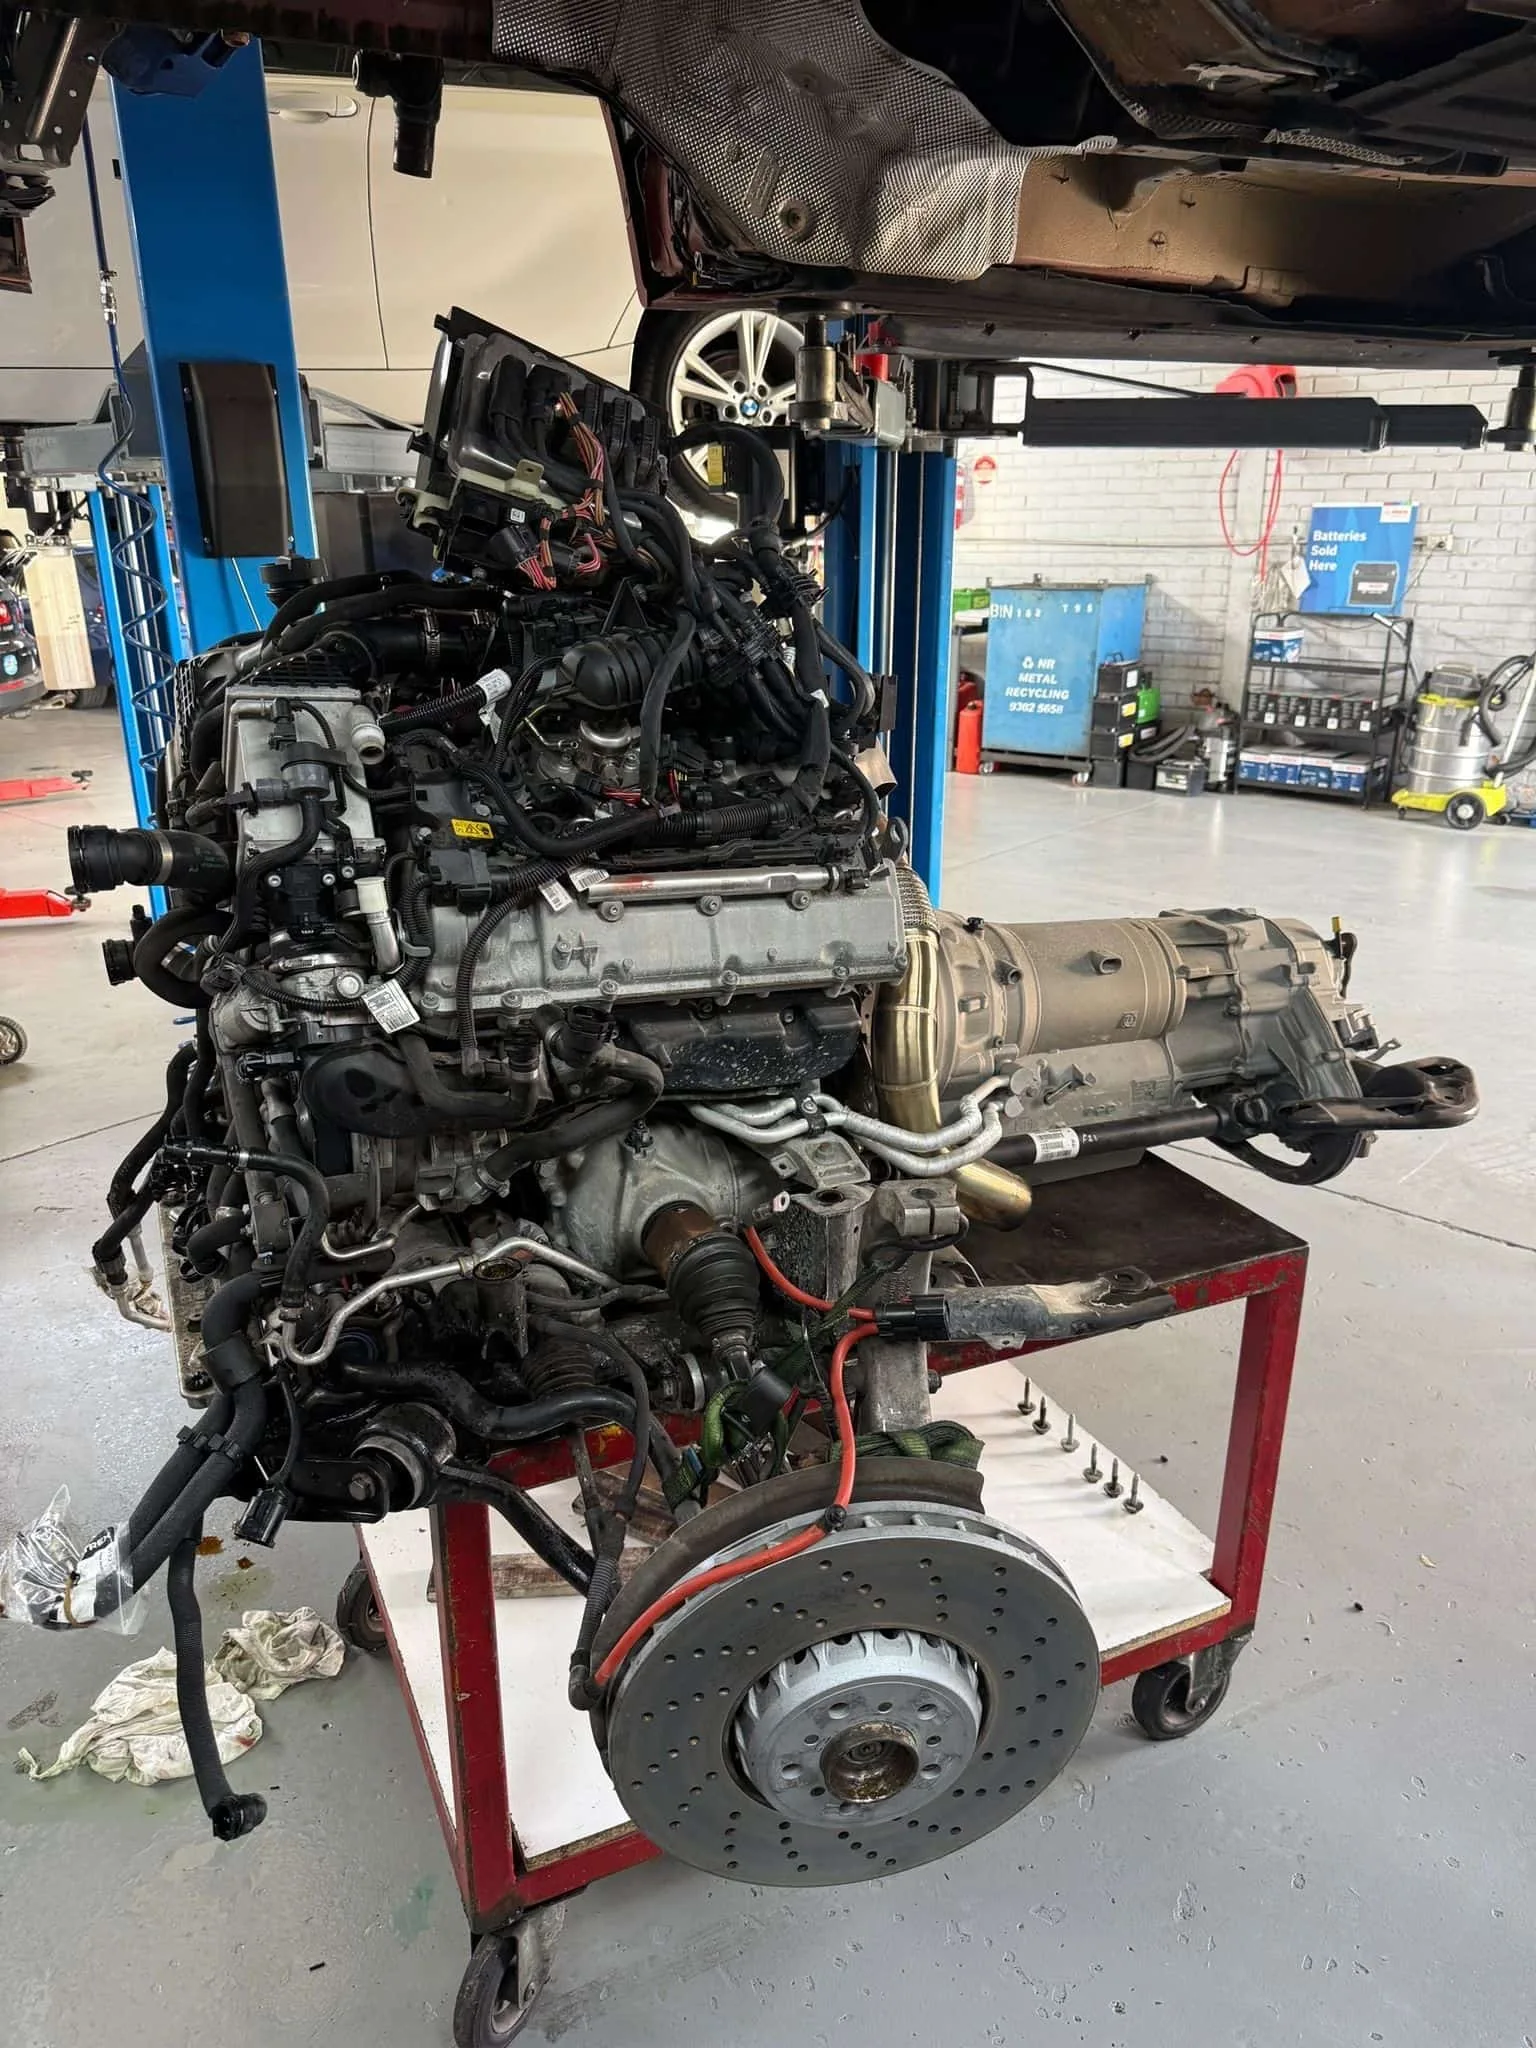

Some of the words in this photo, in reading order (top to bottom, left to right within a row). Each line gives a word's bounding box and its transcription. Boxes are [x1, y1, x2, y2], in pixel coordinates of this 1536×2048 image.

[1313, 530, 1367, 542] Batteries
[1310, 544, 1338, 556] Sold
[1308, 559, 1338, 572] Here
[990, 604, 1013, 619] BIN
[1038, 658, 1056, 669] NR
[1018, 672, 1058, 685] METAL
[1005, 687, 1070, 700] RECYCLING
